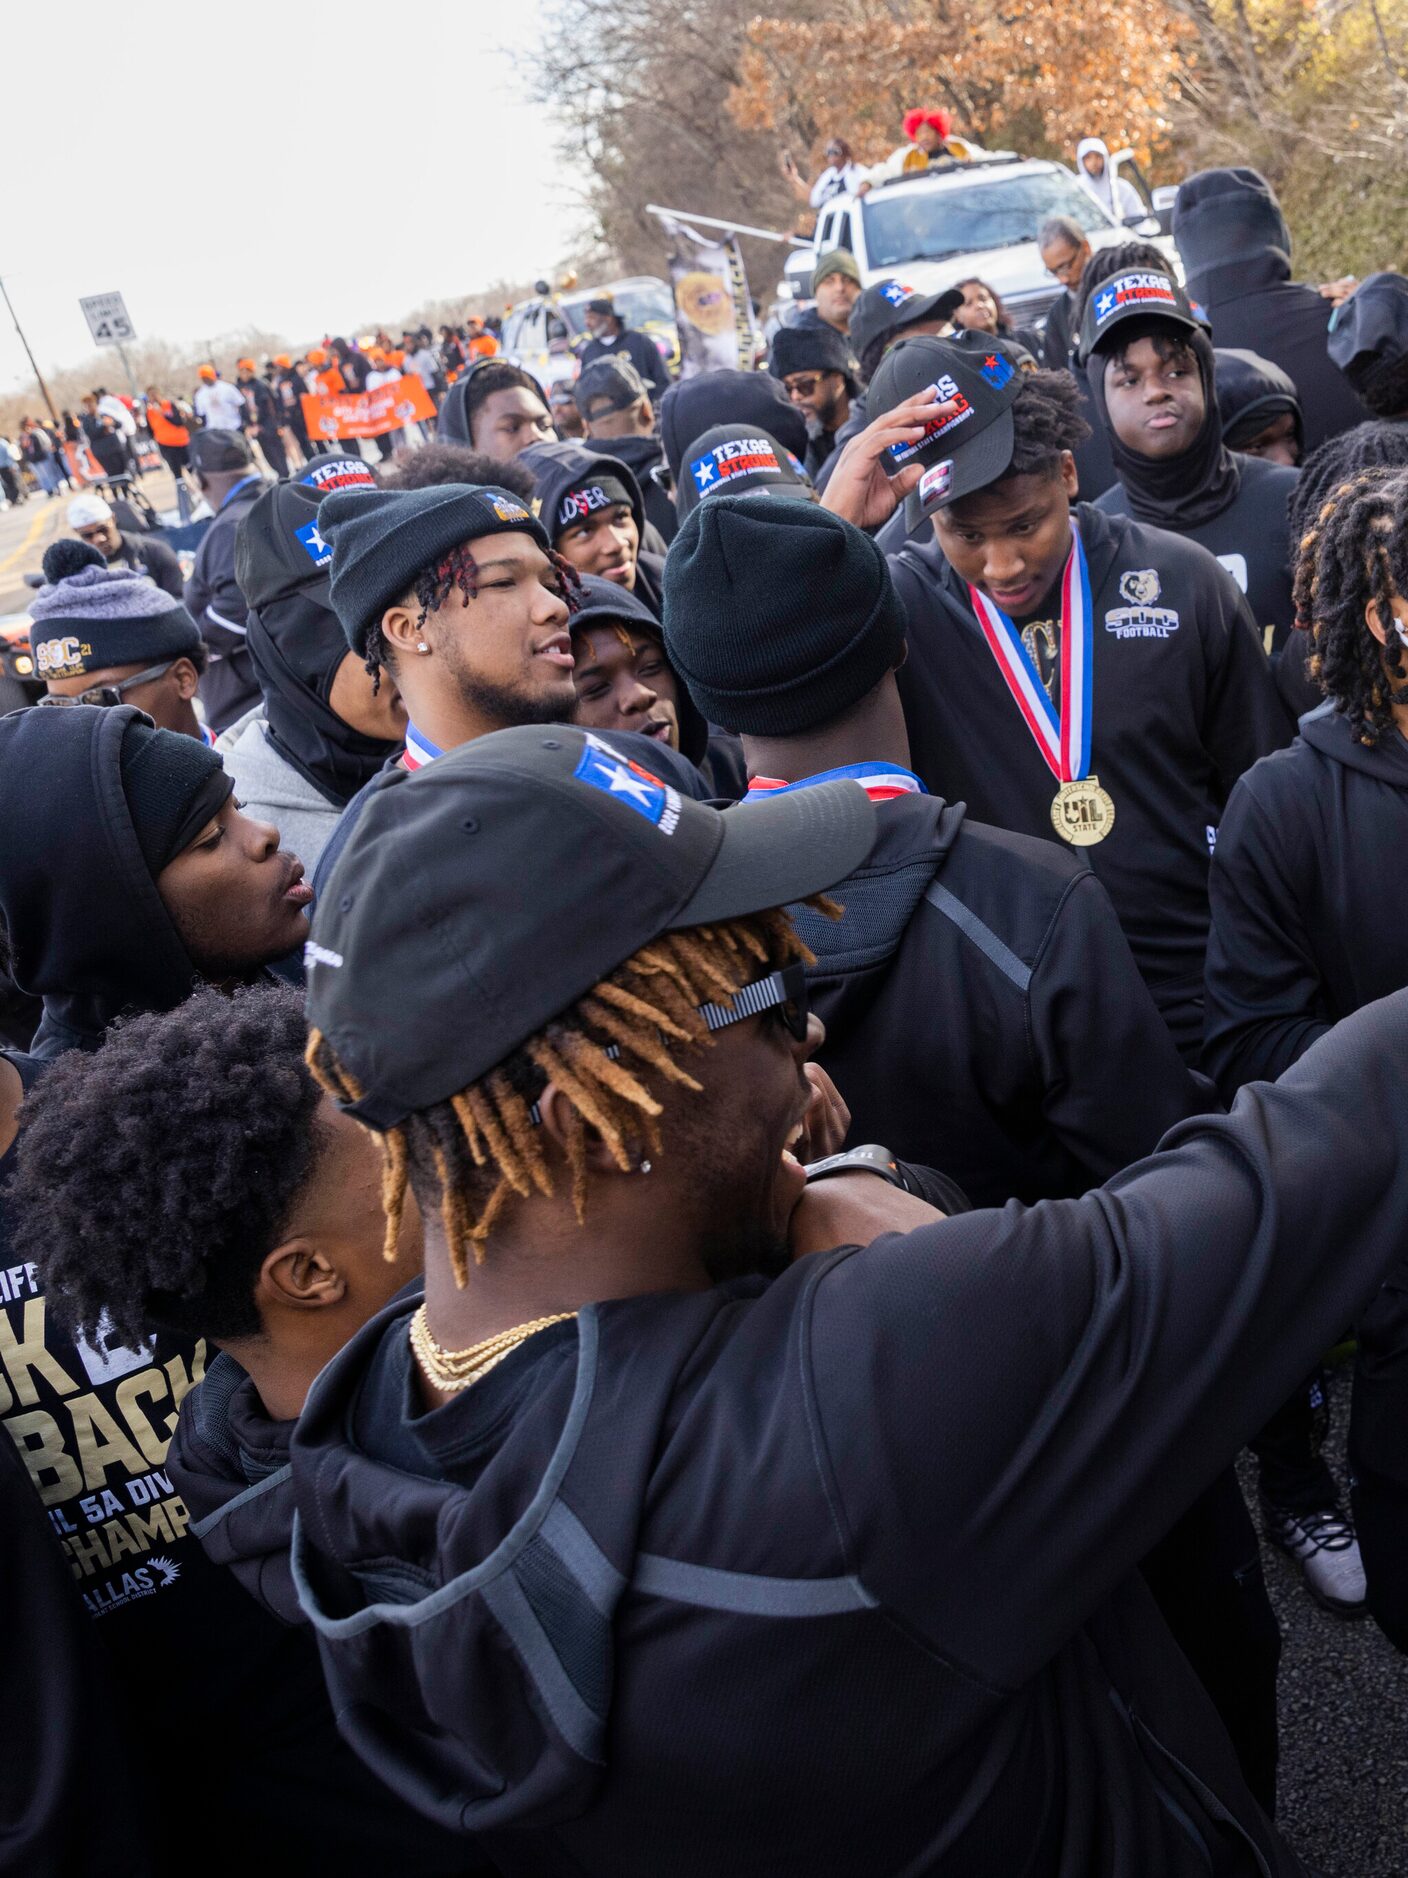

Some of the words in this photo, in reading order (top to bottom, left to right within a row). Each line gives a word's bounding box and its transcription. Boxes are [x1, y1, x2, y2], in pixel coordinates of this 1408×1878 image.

[1114, 274, 1171, 294] TEXAS
[97, 317, 131, 338] 45
[712, 439, 773, 464] TEXAS
[311, 460, 369, 484] TEXAS
[718, 453, 779, 478] STRONG
[1105, 606, 1179, 633] SOC
[1116, 626, 1169, 640] FOOTBALL
[1063, 797, 1103, 824] UIL
[1073, 823, 1097, 832] STATE
[79, 1489, 125, 1524] 5A
